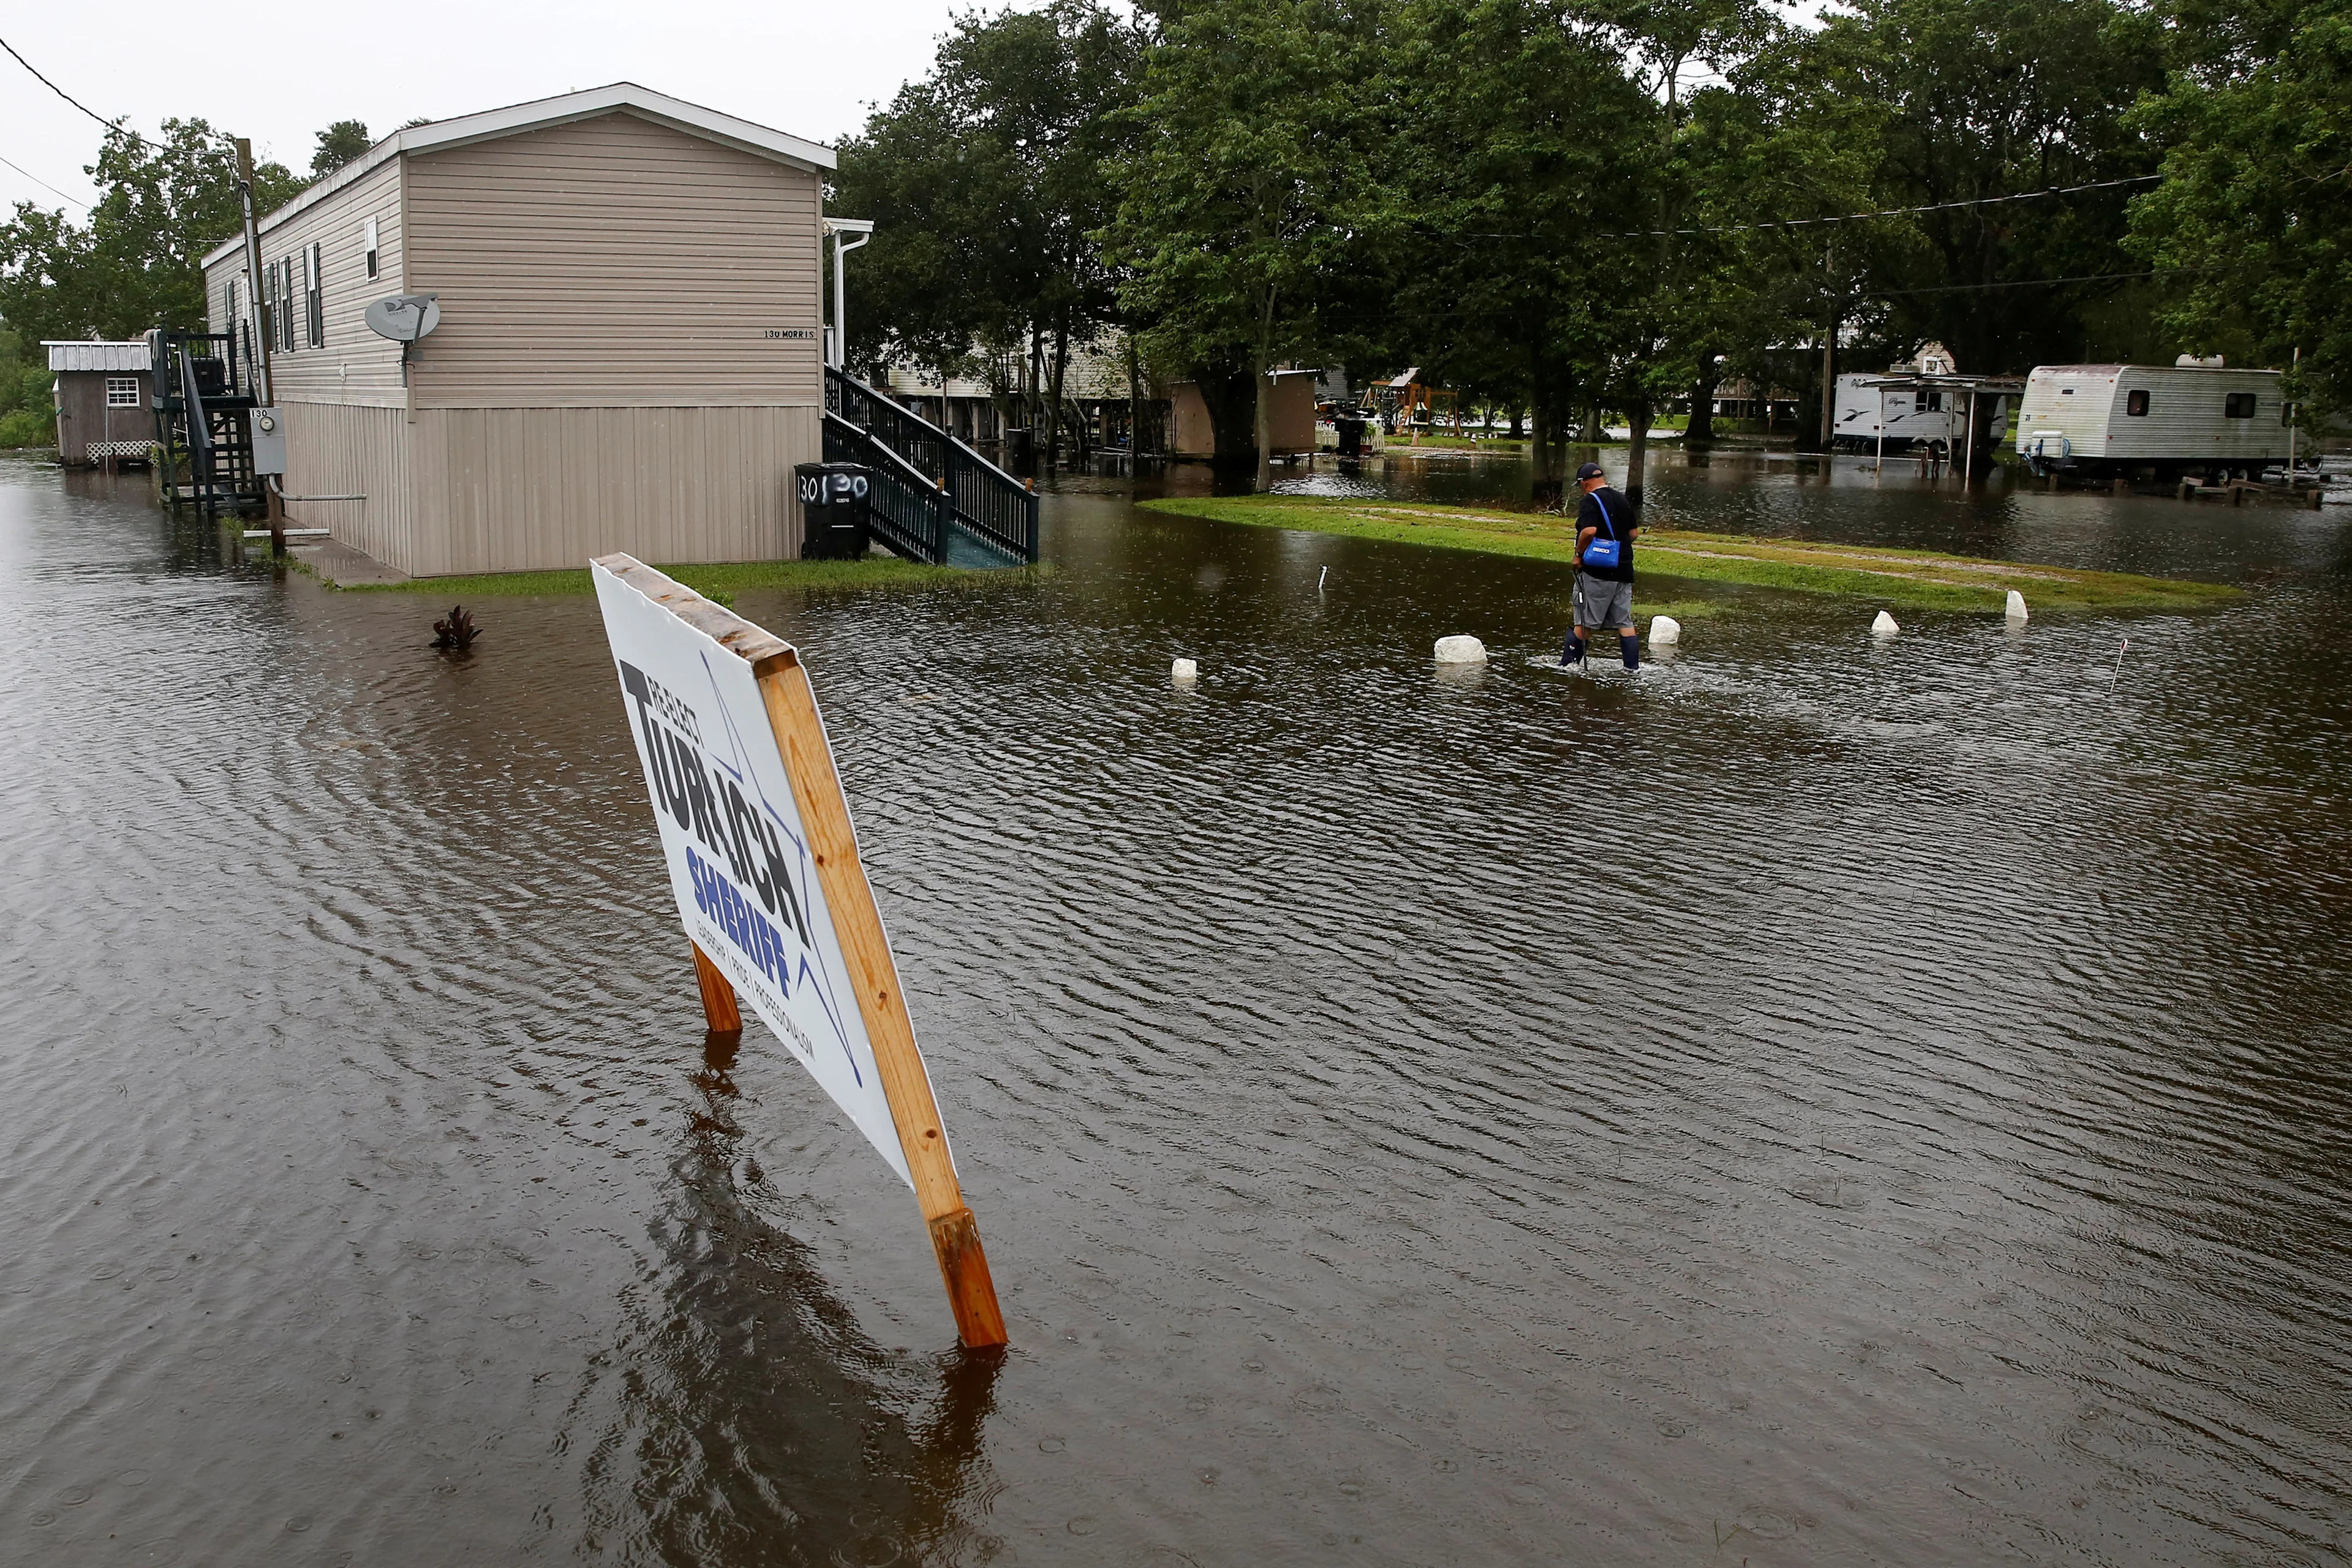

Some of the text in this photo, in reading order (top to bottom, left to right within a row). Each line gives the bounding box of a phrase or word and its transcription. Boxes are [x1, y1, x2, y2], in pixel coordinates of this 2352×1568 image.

[646, 674, 705, 750] RE-ELECT
[686, 846, 791, 1001] SHERIFF
[731, 955, 750, 989] PRIDE
[754, 979, 815, 1062] PROFESSIONALISM
